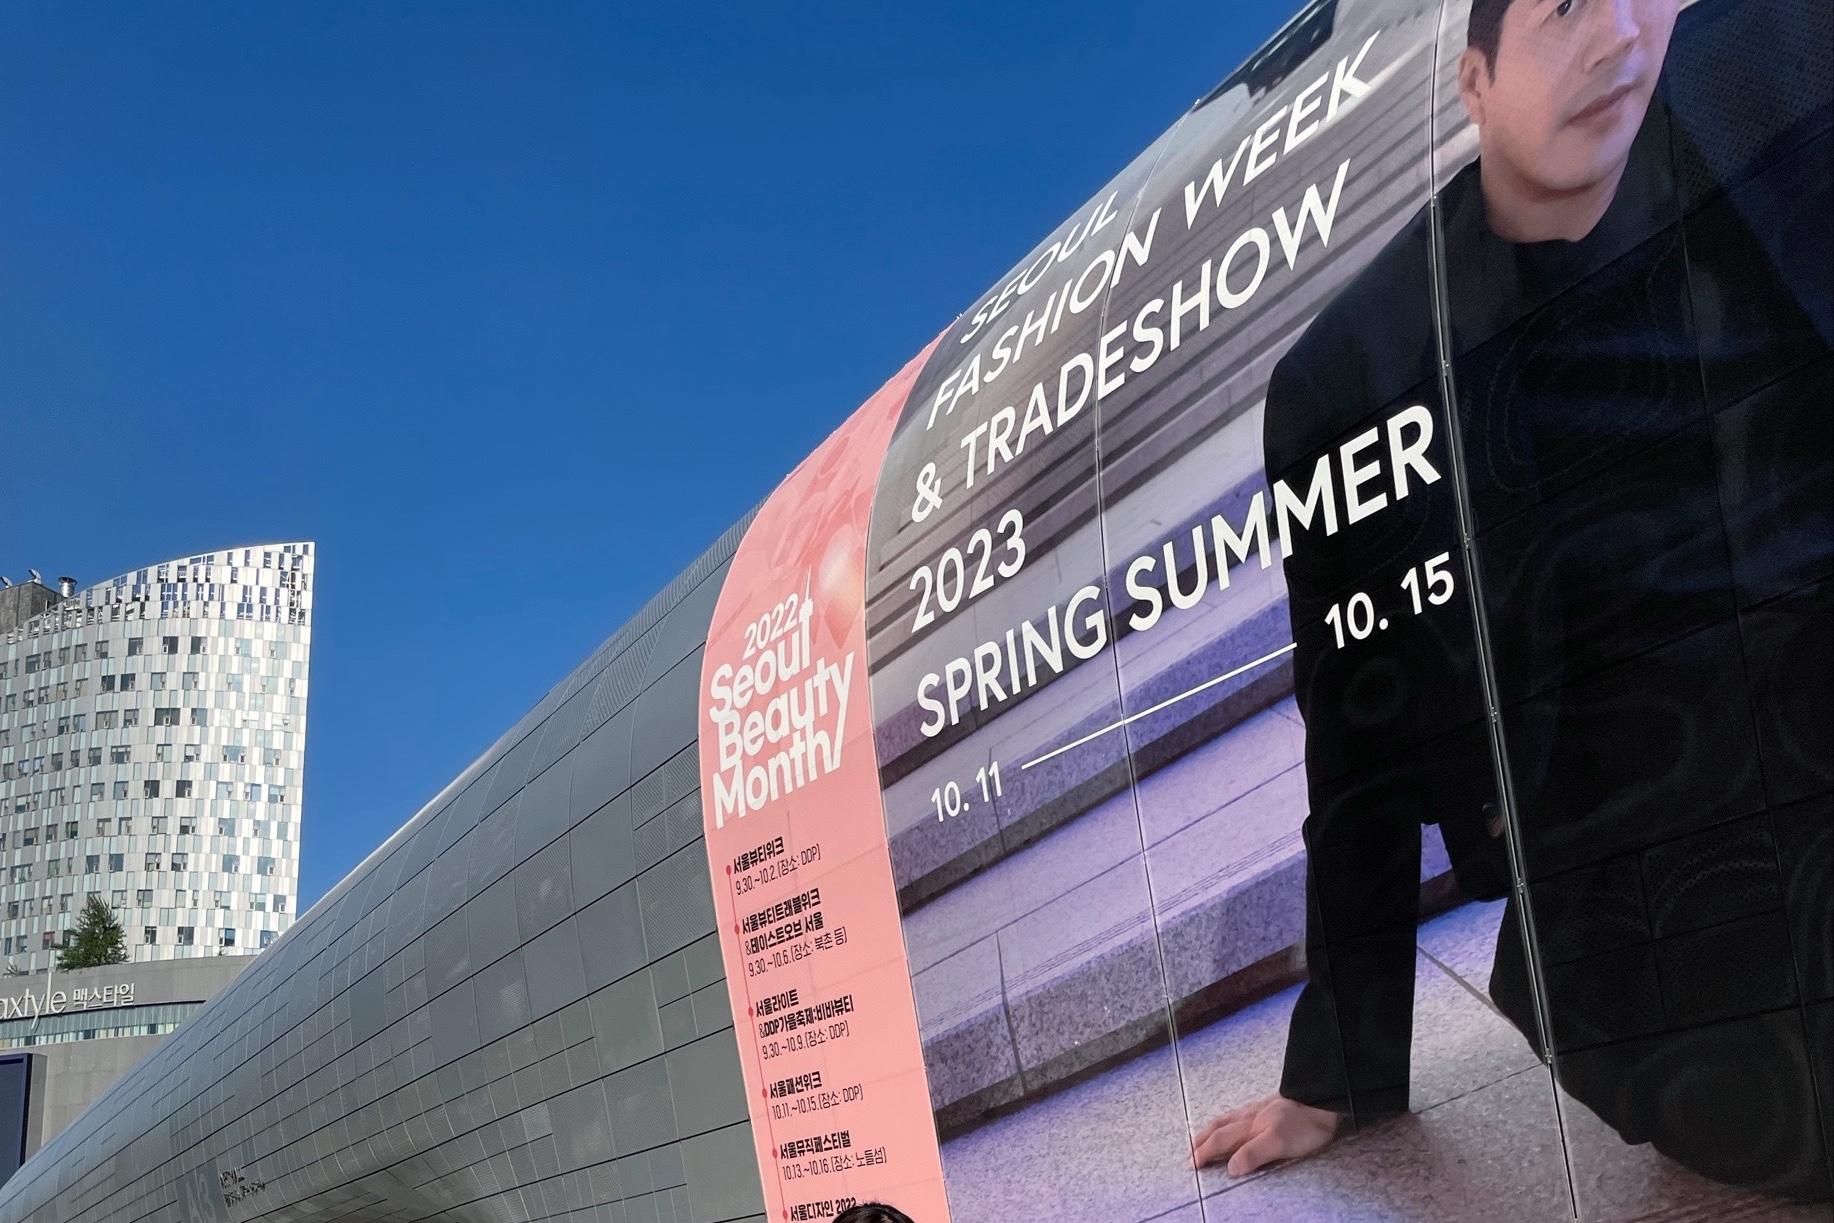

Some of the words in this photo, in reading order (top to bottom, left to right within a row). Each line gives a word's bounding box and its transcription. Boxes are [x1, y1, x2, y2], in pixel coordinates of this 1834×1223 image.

[926, 208, 1161, 431] FASHION
[1184, 30, 1381, 230] WEEK
[960, 190, 1119, 344] SEOUL
[911, 462, 943, 523] &
[960, 158, 1351, 489] TRADESHOW
[909, 509, 1026, 634] 2023
[916, 585, 1108, 738] SPRING
[1125, 405, 1442, 631] SUMMER
[709, 594, 814, 723] Seoul
[742, 593, 798, 660] 2022
[976, 761, 1003, 802] 11
[1401, 552, 1455, 615] 15
[718, 651, 855, 773] Beauty
[712, 722, 834, 829] Month
[734, 836, 785, 875] 서울뷰티위크
[742, 887, 821, 934] 서울뷰티트래블위크
[805, 911, 824, 933] 서울
[815, 932, 833, 951] 북촌
[73, 983, 135, 1010] 맥스타일
[756, 989, 799, 1017] 서울라이트
[769, 1071, 822, 1099] 서울패션위크
[780, 1130, 851, 1160] 서울뮤직페스티벌
[790, 1200, 834, 1221] 서울디자인
